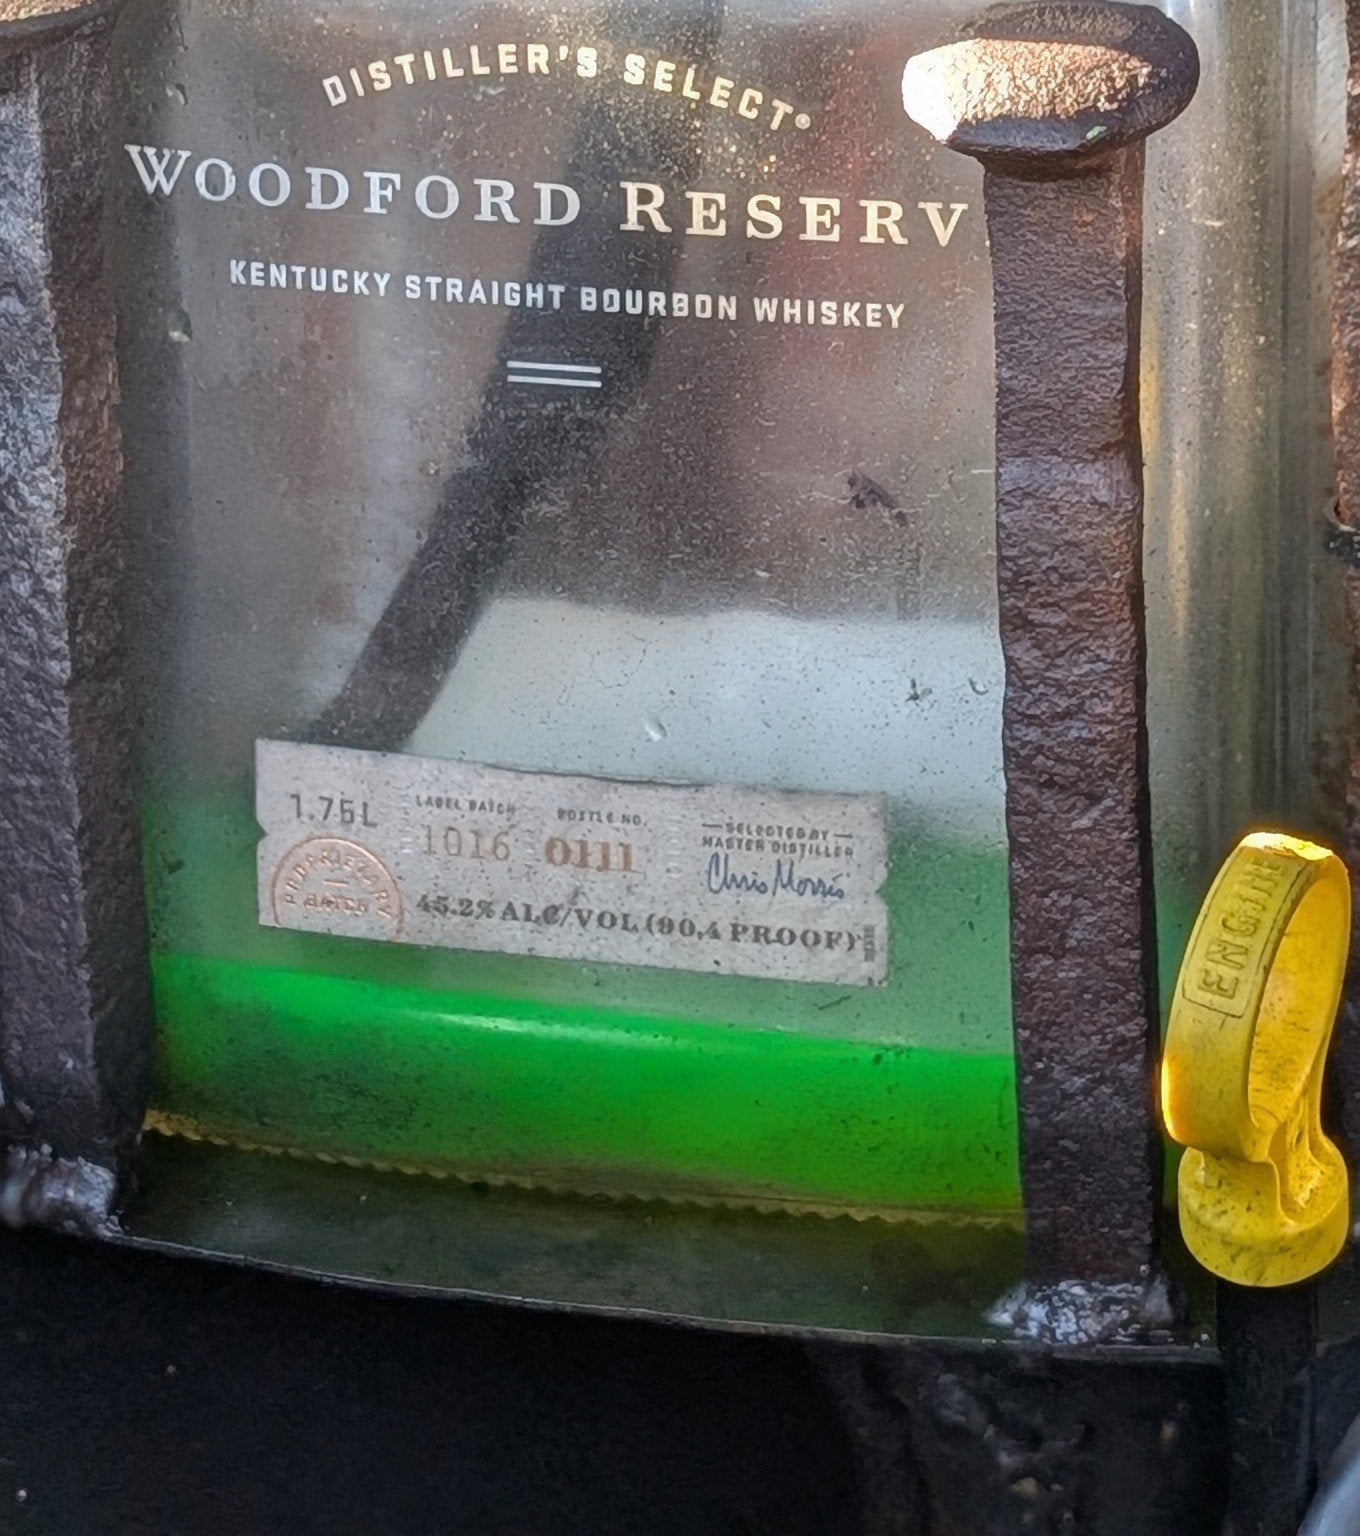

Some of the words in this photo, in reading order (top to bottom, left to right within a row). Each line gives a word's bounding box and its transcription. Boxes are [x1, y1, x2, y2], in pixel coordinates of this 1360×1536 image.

[323, 42, 599, 108] DISTILLER'S
[125, 142, 583, 229] WOODFORD
[621, 179, 970, 248] RESERV
[229, 259, 392, 298] KENTUCKY
[404, 272, 566, 313] STRAIGHT
[580, 285, 738, 322] BOURBON
[753, 295, 907, 330] WHISKEY
[289, 793, 379, 828] 1.75L
[415, 795, 461, 811] LABEL
[468, 798, 516, 816] BATCH
[421, 824, 512, 862] 1016
[701, 836, 765, 852] MASTER
[770, 840, 854, 859] DISTILLER
[725, 821, 806, 840] SELECTED
[544, 835, 637, 873] 0111
[706, 851, 767, 895] Chris
[415, 893, 495, 921] 45.2%
[500, 900, 639, 932] ALC/VOL
[645, 913, 721, 943] (90.4
[730, 922, 856, 951] PROOF)
[1196, 855, 1281, 1001] ENGINE
